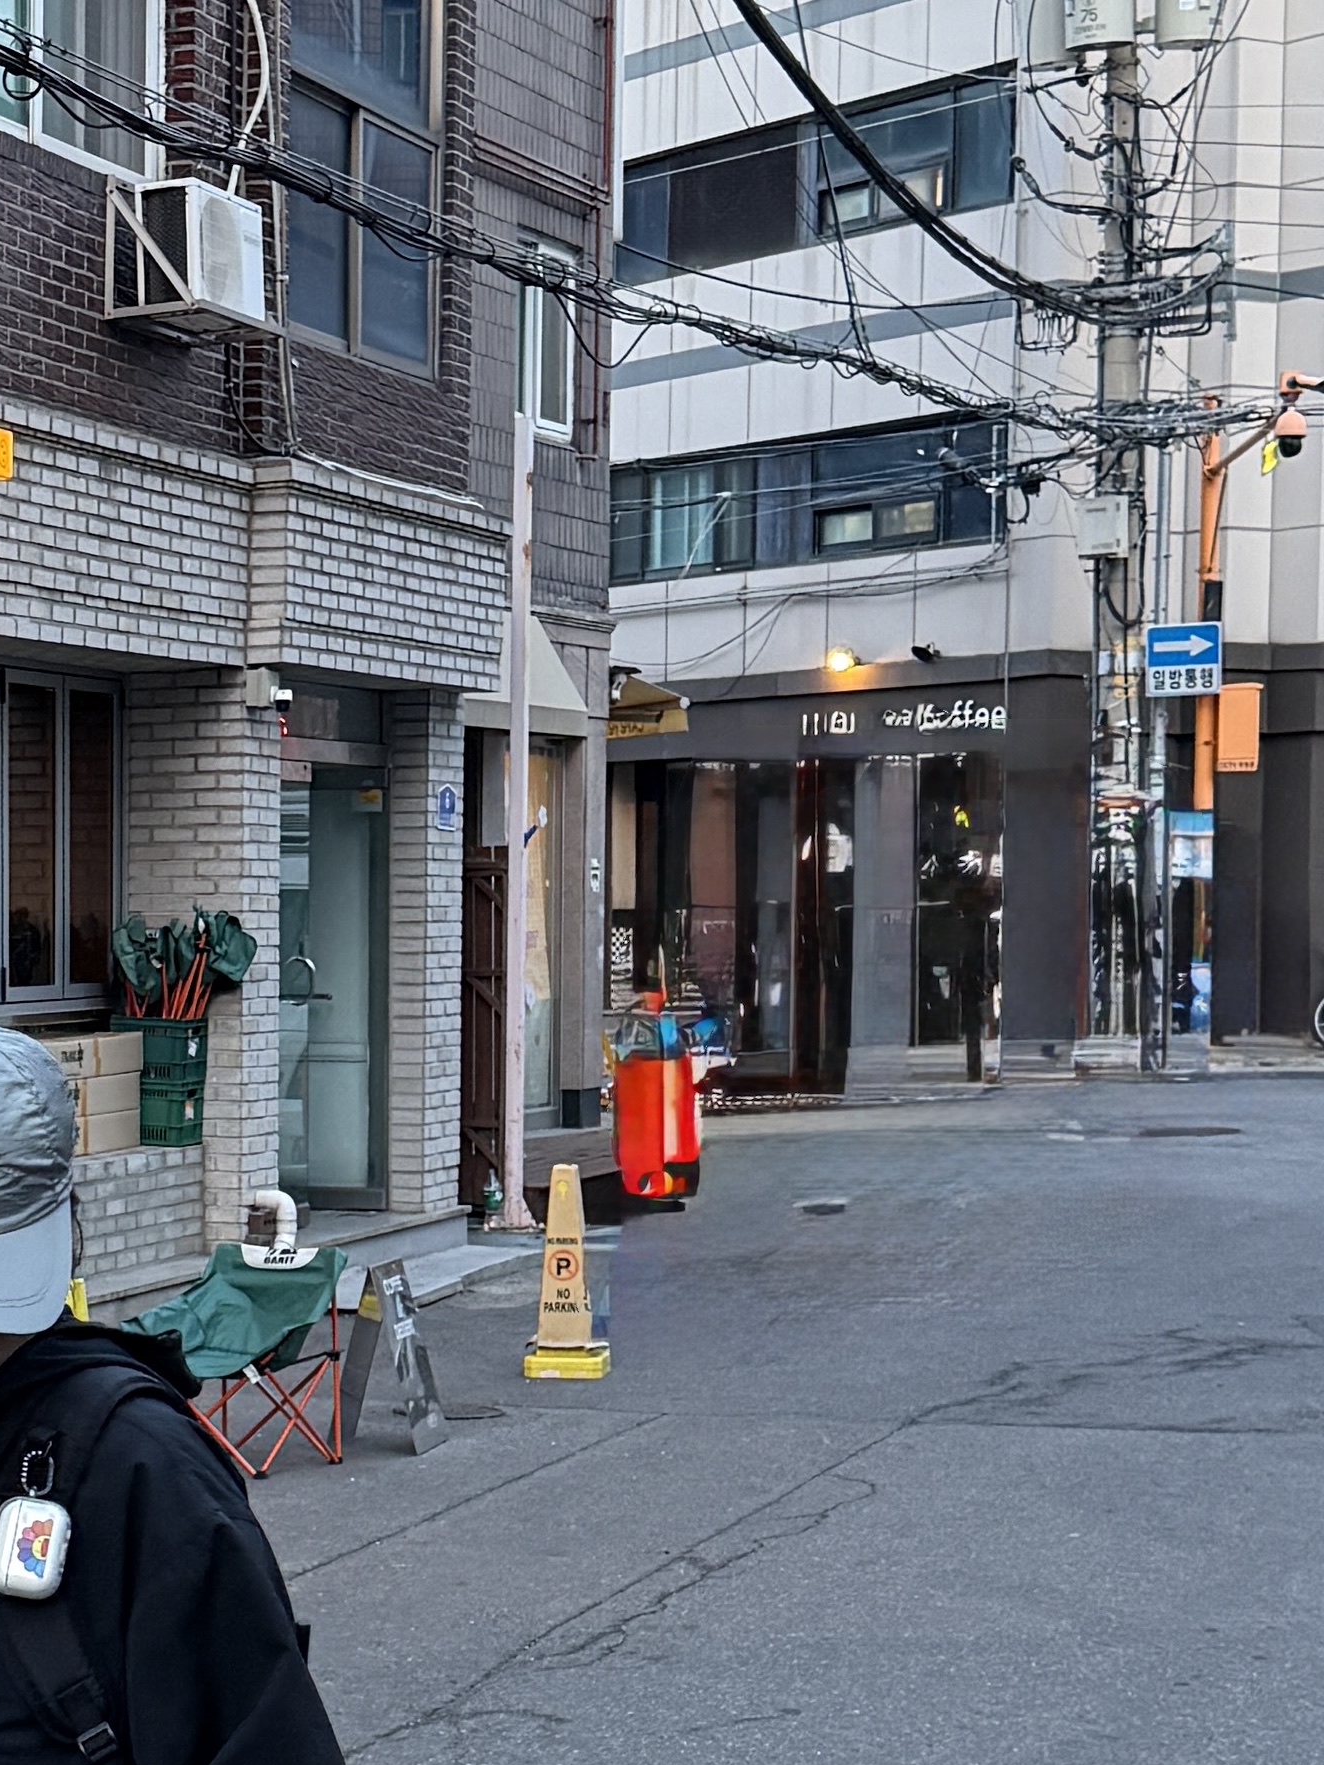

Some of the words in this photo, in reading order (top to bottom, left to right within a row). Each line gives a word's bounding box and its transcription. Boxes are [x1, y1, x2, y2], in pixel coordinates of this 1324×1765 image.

[1080, 8, 1098, 23] 75
[1152, 667, 1213, 690] 일방통행
[556, 1288, 571, 1299] NO
